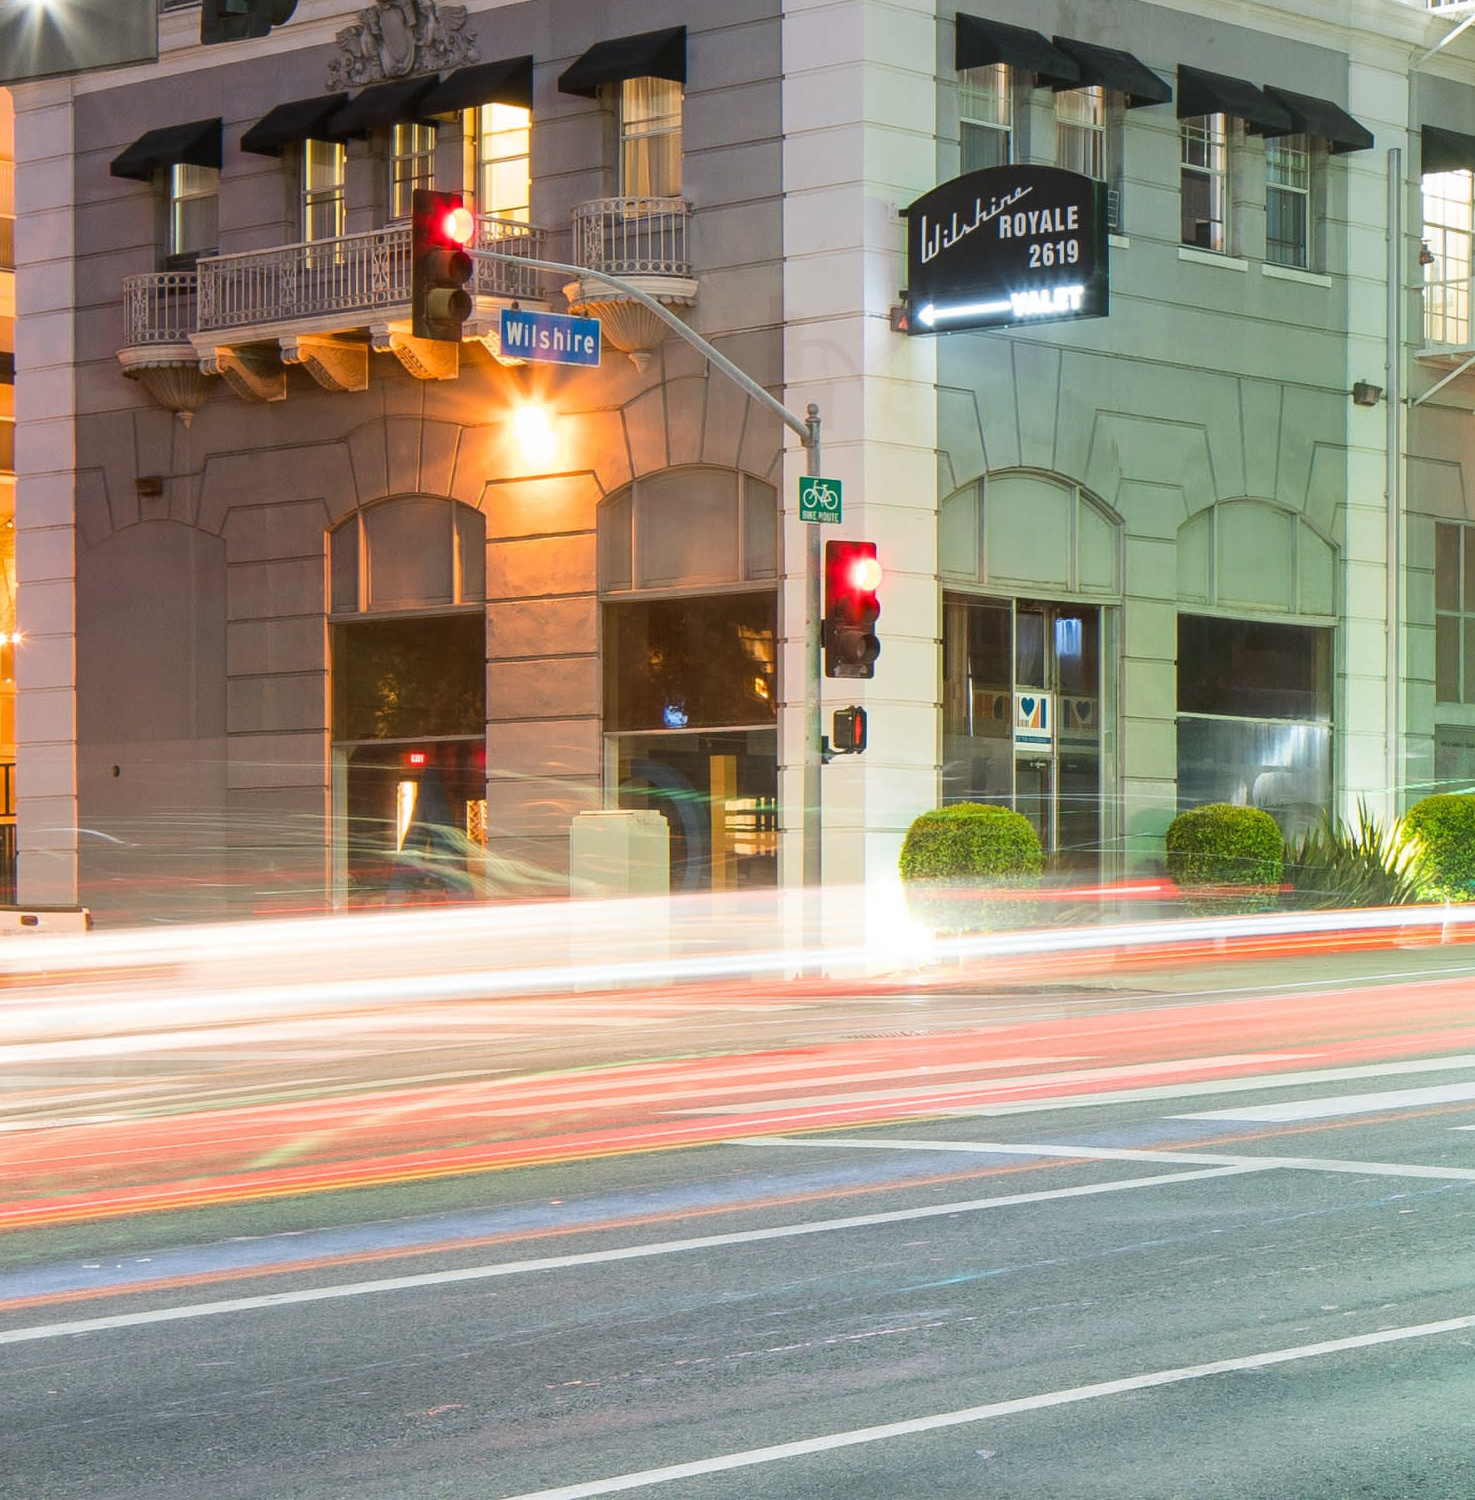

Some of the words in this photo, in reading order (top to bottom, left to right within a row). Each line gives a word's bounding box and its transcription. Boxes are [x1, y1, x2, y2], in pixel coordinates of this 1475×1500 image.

[921, 186, 1033, 265] Wilshire
[999, 205, 1079, 239] ROYALE
[1029, 239, 1079, 268] 2619
[1010, 285, 1084, 317] VALET
[505, 320, 596, 355] Wilshire
[802, 510, 817, 520] BIKE
[818, 511, 839, 523] ROUTE
